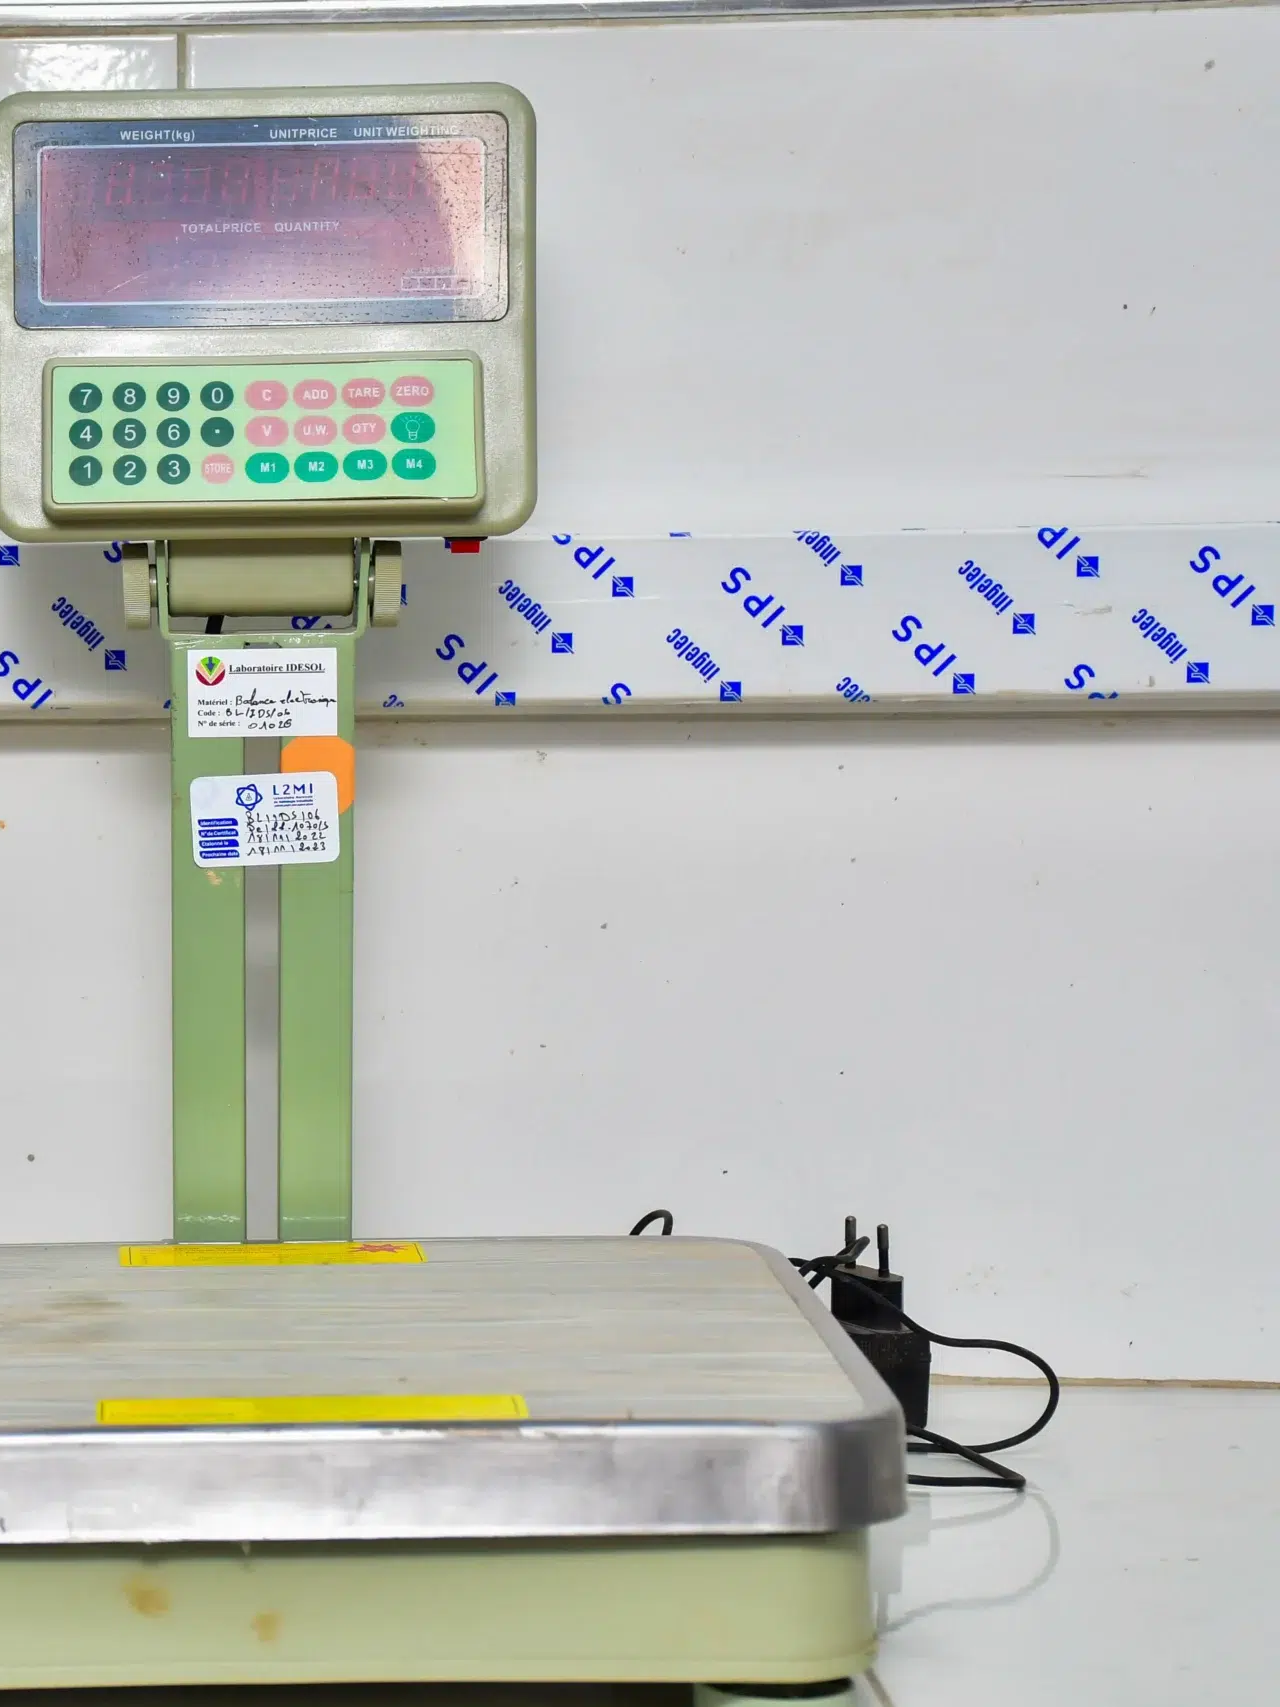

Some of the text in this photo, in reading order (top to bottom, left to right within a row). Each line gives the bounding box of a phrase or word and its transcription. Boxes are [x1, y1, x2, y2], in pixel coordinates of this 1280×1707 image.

[120, 129, 195, 142] WEIGHT(kg)
[269, 127, 338, 140] UNITPRICE
[353, 124, 460, 138] UNIT WEIGHTING
[274, 221, 340, 233] QUANTITY
[80, 385, 430, 406] 7 8 9 0 C ADD TARE ZERO
[79, 425, 93, 442] 4
[124, 424, 137, 442] 5
[167, 423, 181, 441] 6
[262, 424, 272, 437] V
[303, 424, 329, 436] U.W.
[352, 423, 377, 434] QTY
[82, 458, 423, 479] 1 2 3 STORE M1 M2 M3 M4
[957, 559, 1015, 615] ingelec
[1188, 544, 1257, 609] IPS
[498, 579, 552, 634] ingelec
[720, 566, 786, 629] IPS
[51, 596, 105, 652] ingelec
[891, 614, 958, 678] IPS
[1131, 607, 1189, 664] ingelec
[435, 633, 499, 695] IPS
[665, 627, 721, 681] ingelec
[229, 663, 326, 673] Laboratoire IDESOL
[197, 698, 228, 706] Matériel
[197, 709, 216, 717] Code
[219, 719, 236, 727] série
[273, 783, 313, 796] L2MI
